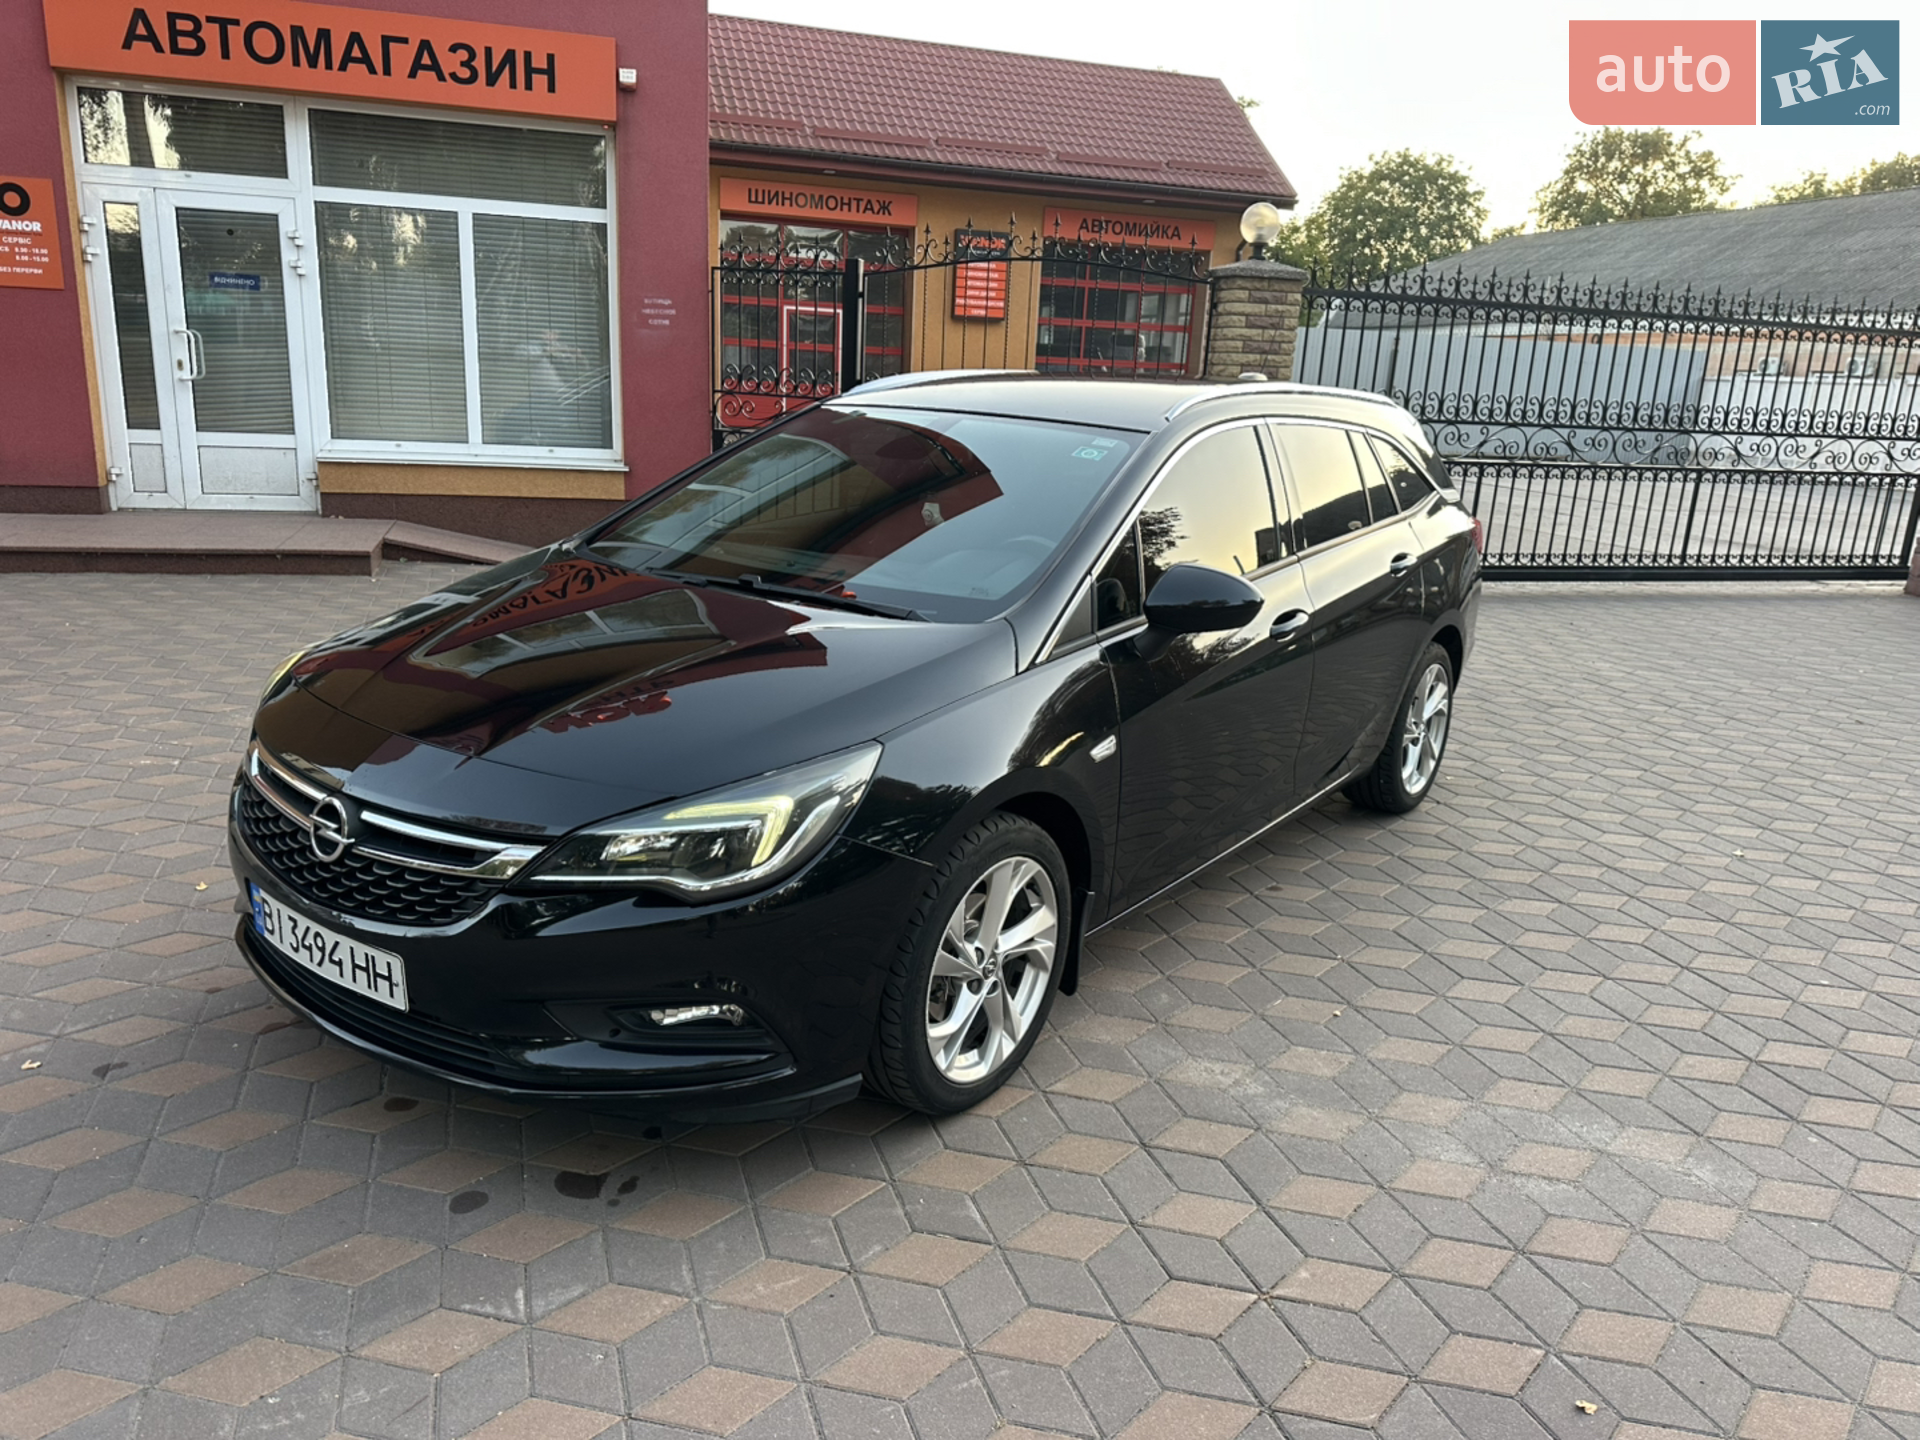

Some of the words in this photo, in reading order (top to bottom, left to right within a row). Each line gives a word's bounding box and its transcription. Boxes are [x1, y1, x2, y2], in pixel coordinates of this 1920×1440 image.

[121, 7, 557, 94] АВТОМАГАЗИН
[747, 187, 893, 217] ШИНОМОНТАЖ
[1078, 217, 1182, 241] АВТОМИЙКА
[263, 897, 284, 945] BI
[287, 914, 344, 979] 3494
[349, 945, 395, 1000] HH
